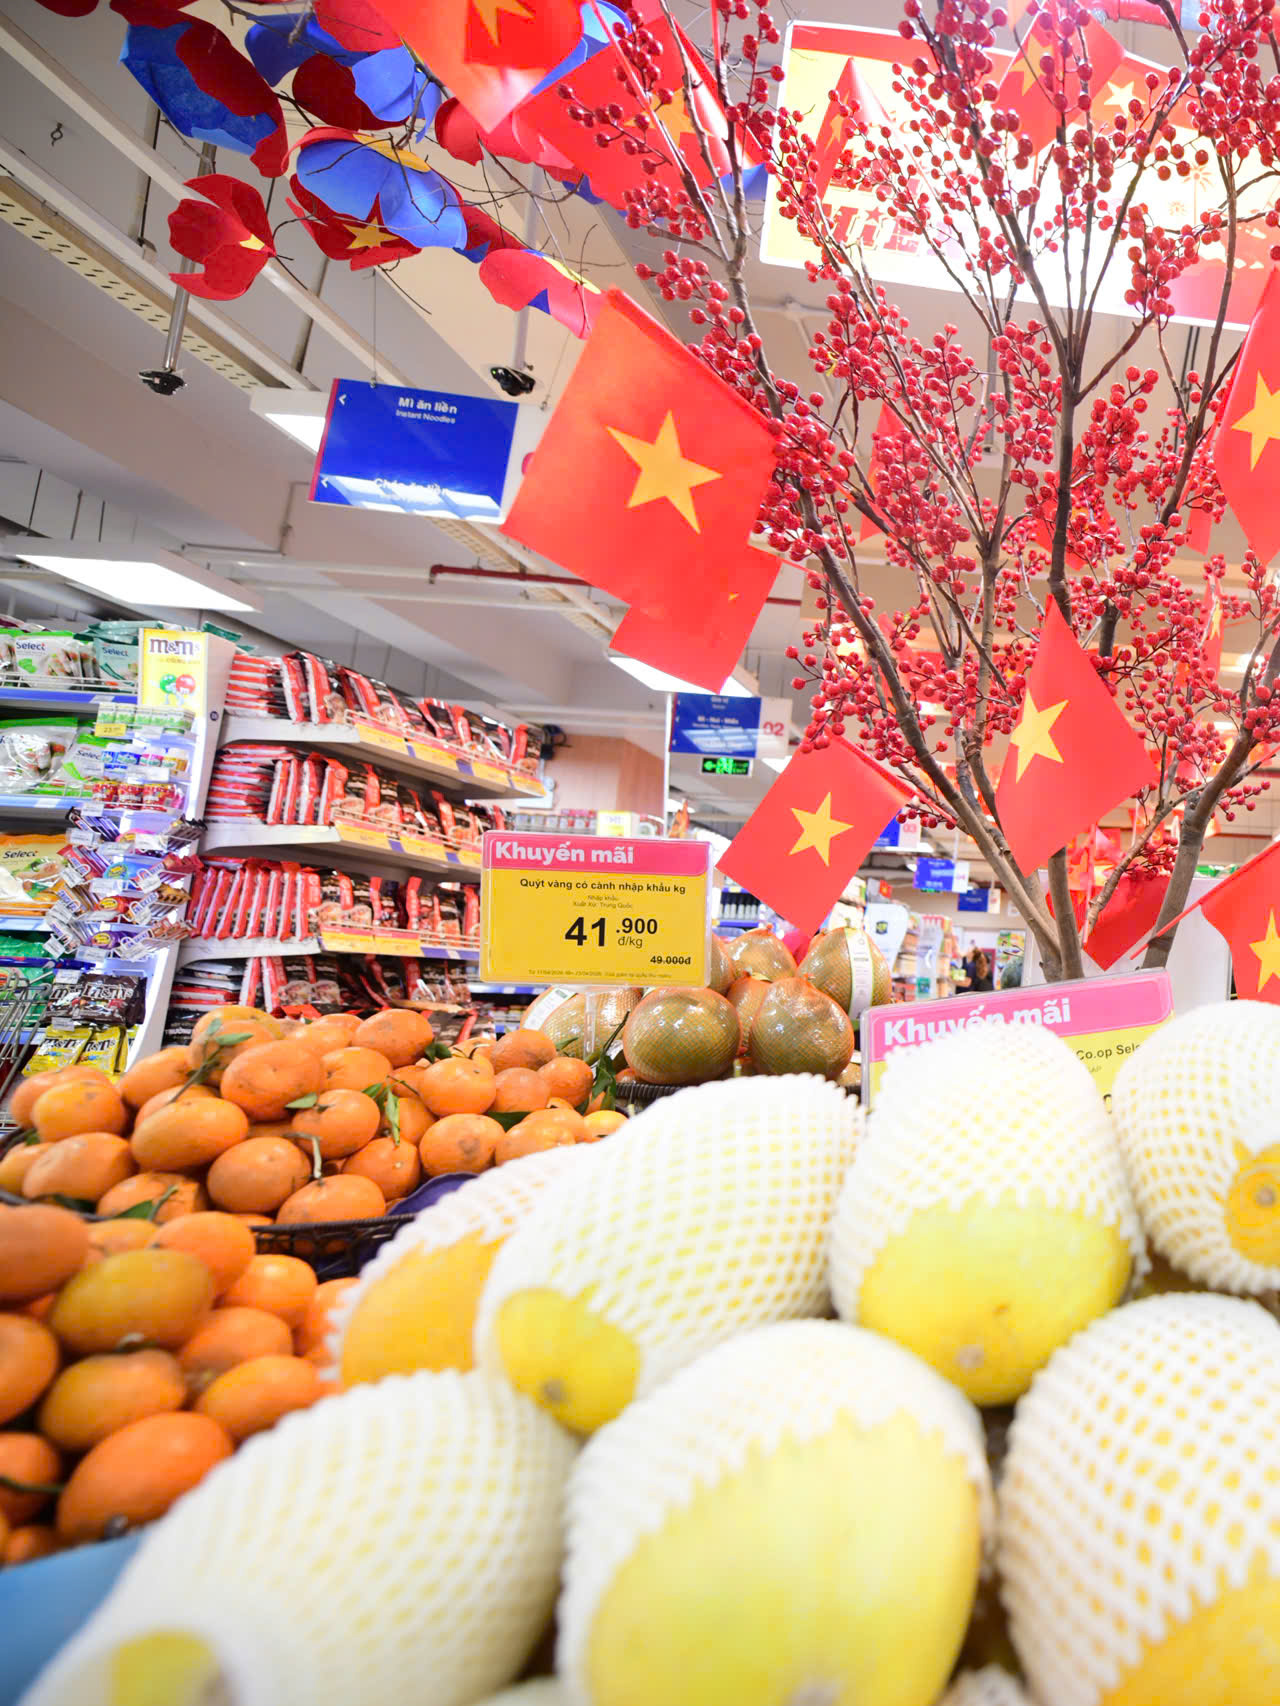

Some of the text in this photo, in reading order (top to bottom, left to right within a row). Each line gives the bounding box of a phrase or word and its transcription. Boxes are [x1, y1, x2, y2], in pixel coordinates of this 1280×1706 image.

[763, 721, 785, 736] 02
[77, 750, 100, 759] Selec
[495, 841, 634, 866] Khuyến mãi
[548, 880, 572, 890] vàng
[575, 880, 588, 889] có
[618, 882, 644, 892] nhập
[673, 884, 686, 894] kg
[564, 916, 659, 947] 41 .900
[617, 936, 643, 948] đ/kg
[1010, 998, 1072, 1026] mãi
[1076, 1048, 1113, 1061] Co.op
